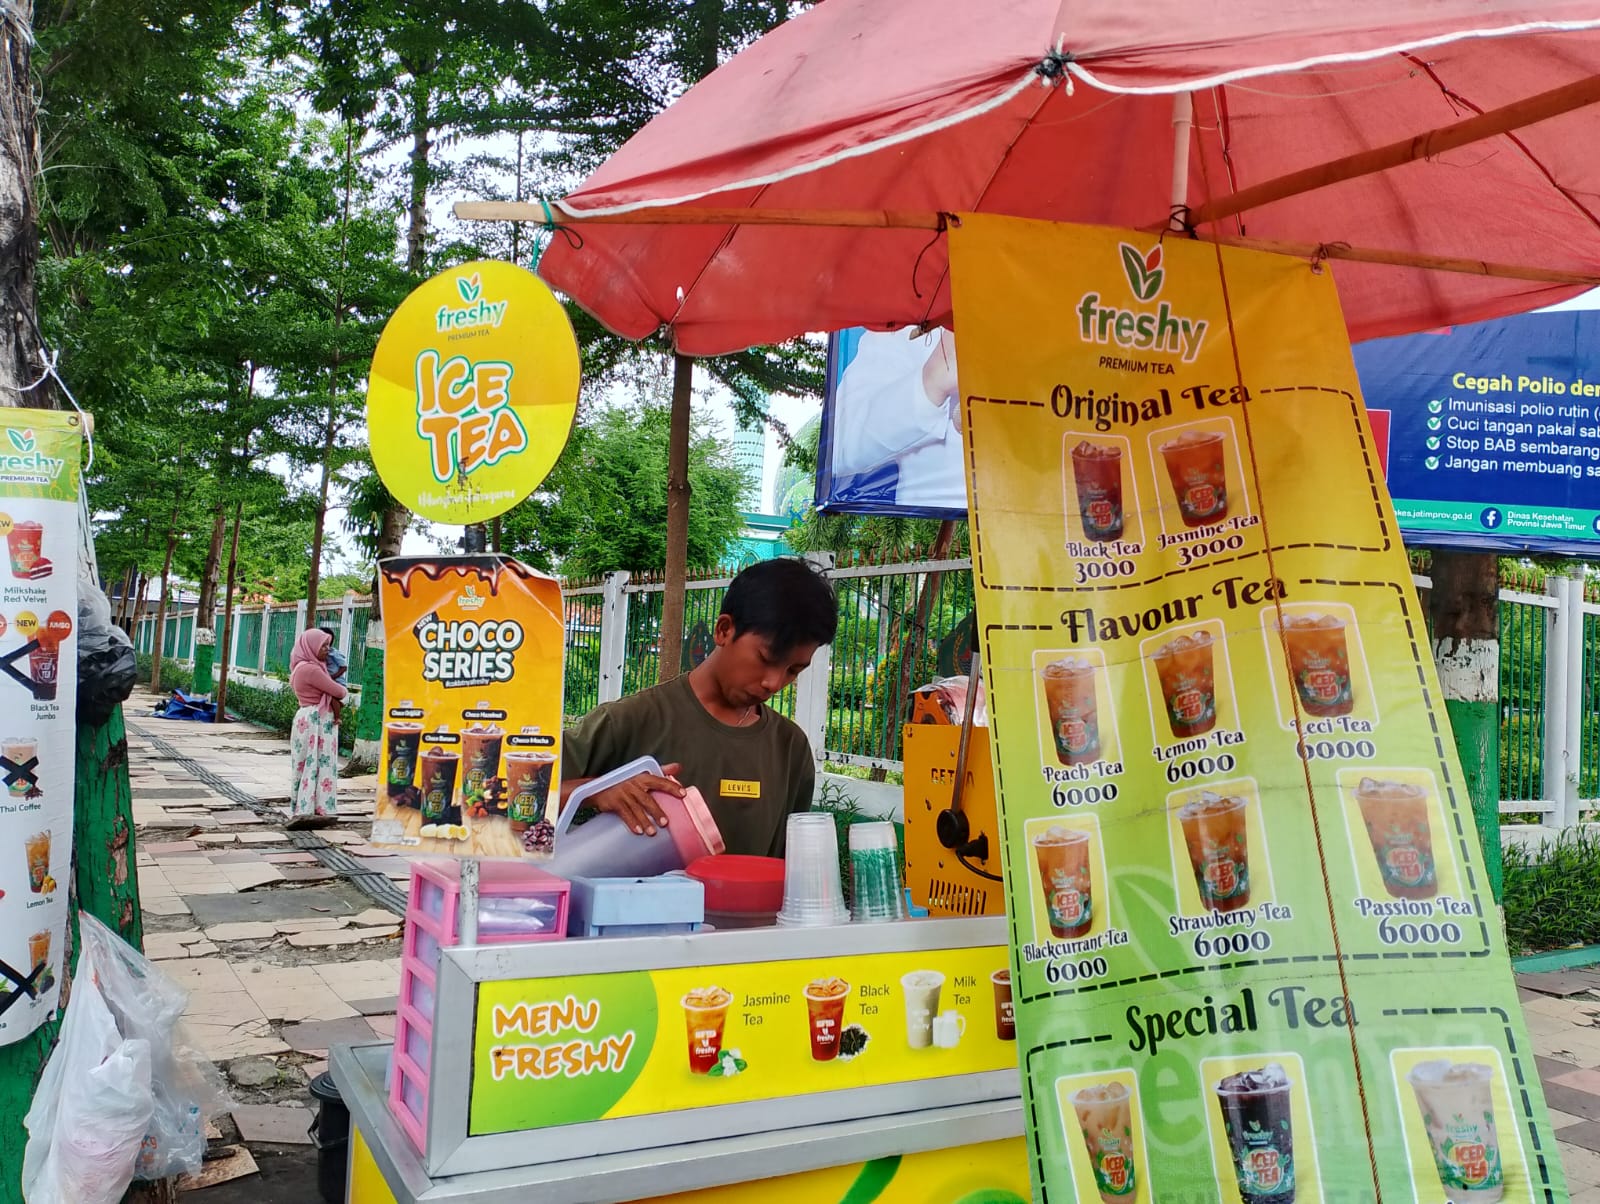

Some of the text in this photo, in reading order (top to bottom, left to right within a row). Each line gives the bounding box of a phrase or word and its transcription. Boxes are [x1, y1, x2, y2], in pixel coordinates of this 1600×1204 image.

[435, 298, 507, 331] freshy
[448, 332, 476, 341] PREMIUM
[1077, 293, 1207, 362] freshy
[1099, 356, 1175, 375] PREMIUM TEA
[418, 351, 511, 415] ICE
[1452, 372, 1513, 394] Cegah
[1518, 376, 1566, 394] Polio
[1050, 383, 1252, 432] Original Tea
[1448, 397, 1516, 414] Imunisasi
[1520, 402, 1554, 417] polio
[1558, 405, 1589, 418] rutin
[1447, 416, 1480, 431] Cuci
[1484, 418, 1533, 436] tangan
[1537, 422, 1576, 437] pakai
[419, 411, 526, 480] TEA
[1446, 435, 1600, 460] Stop BAB sembarang
[1445, 455, 1498, 472] Jangan
[1503, 460, 1582, 478] membuang
[1507, 511, 1574, 522] Dinas Kesehatan
[1507, 519, 1587, 531] Provinsi Jawa Timur
[1157, 514, 1259, 551] Jasmine Tea
[1066, 541, 1141, 559] Black Tea
[1177, 535, 1243, 566] 3000
[1074, 560, 1135, 584] 3000
[4, 587, 46, 595] Milkshake
[23, 596, 48, 604] Velvet
[1060, 577, 1288, 643] Flavour Tea
[417, 614, 433, 630] NEW
[419, 621, 523, 650] CHOCO
[424, 651, 513, 679] SERIES
[1310, 673, 1336, 686] ICED
[1317, 686, 1338, 698] TEA
[31, 704, 48, 712] Black
[36, 712, 56, 720] Jumbo
[1337, 717, 1372, 733] Tea
[1153, 730, 1244, 761] Lemon Tea
[1296, 740, 1375, 760] 6000
[1043, 761, 1123, 783] Peach Tea
[1167, 754, 1235, 783] 6000
[728, 784, 752, 792] LEVI'S
[1053, 783, 1118, 807] 6000
[18, 804, 41, 812] Coffee
[26, 900, 45, 908] Lemon
[1057, 893, 1079, 907] ICED
[1354, 897, 1473, 917] Passion Tea
[1169, 903, 1291, 935] Strawberry Tea
[1379, 916, 1461, 944] 6000
[1023, 929, 1128, 962] Blackcurrant Tea
[1194, 931, 1270, 957] 6000
[1046, 957, 1107, 983] 6000
[860, 984, 890, 998] Black
[954, 976, 976, 988] Milk
[742, 992, 790, 1007] Jasmine
[953, 994, 972, 1006] Tea
[494, 996, 599, 1036] MENU
[743, 1013, 763, 1026] Tea
[859, 1004, 878, 1016] Tea
[1126, 986, 1359, 1056] Special Tea
[816, 1034, 835, 1043] freshy
[492, 1031, 634, 1080] FRESHY
[696, 1046, 716, 1055] freshy
[1251, 1151, 1278, 1168] ICED
[1455, 1144, 1485, 1162] ICED
[1105, 1156, 1125, 1170] ICED
[1464, 1161, 1487, 1178] TEA
[1112, 1170, 1126, 1185] TEA
[1256, 1168, 1279, 1184] TEA
